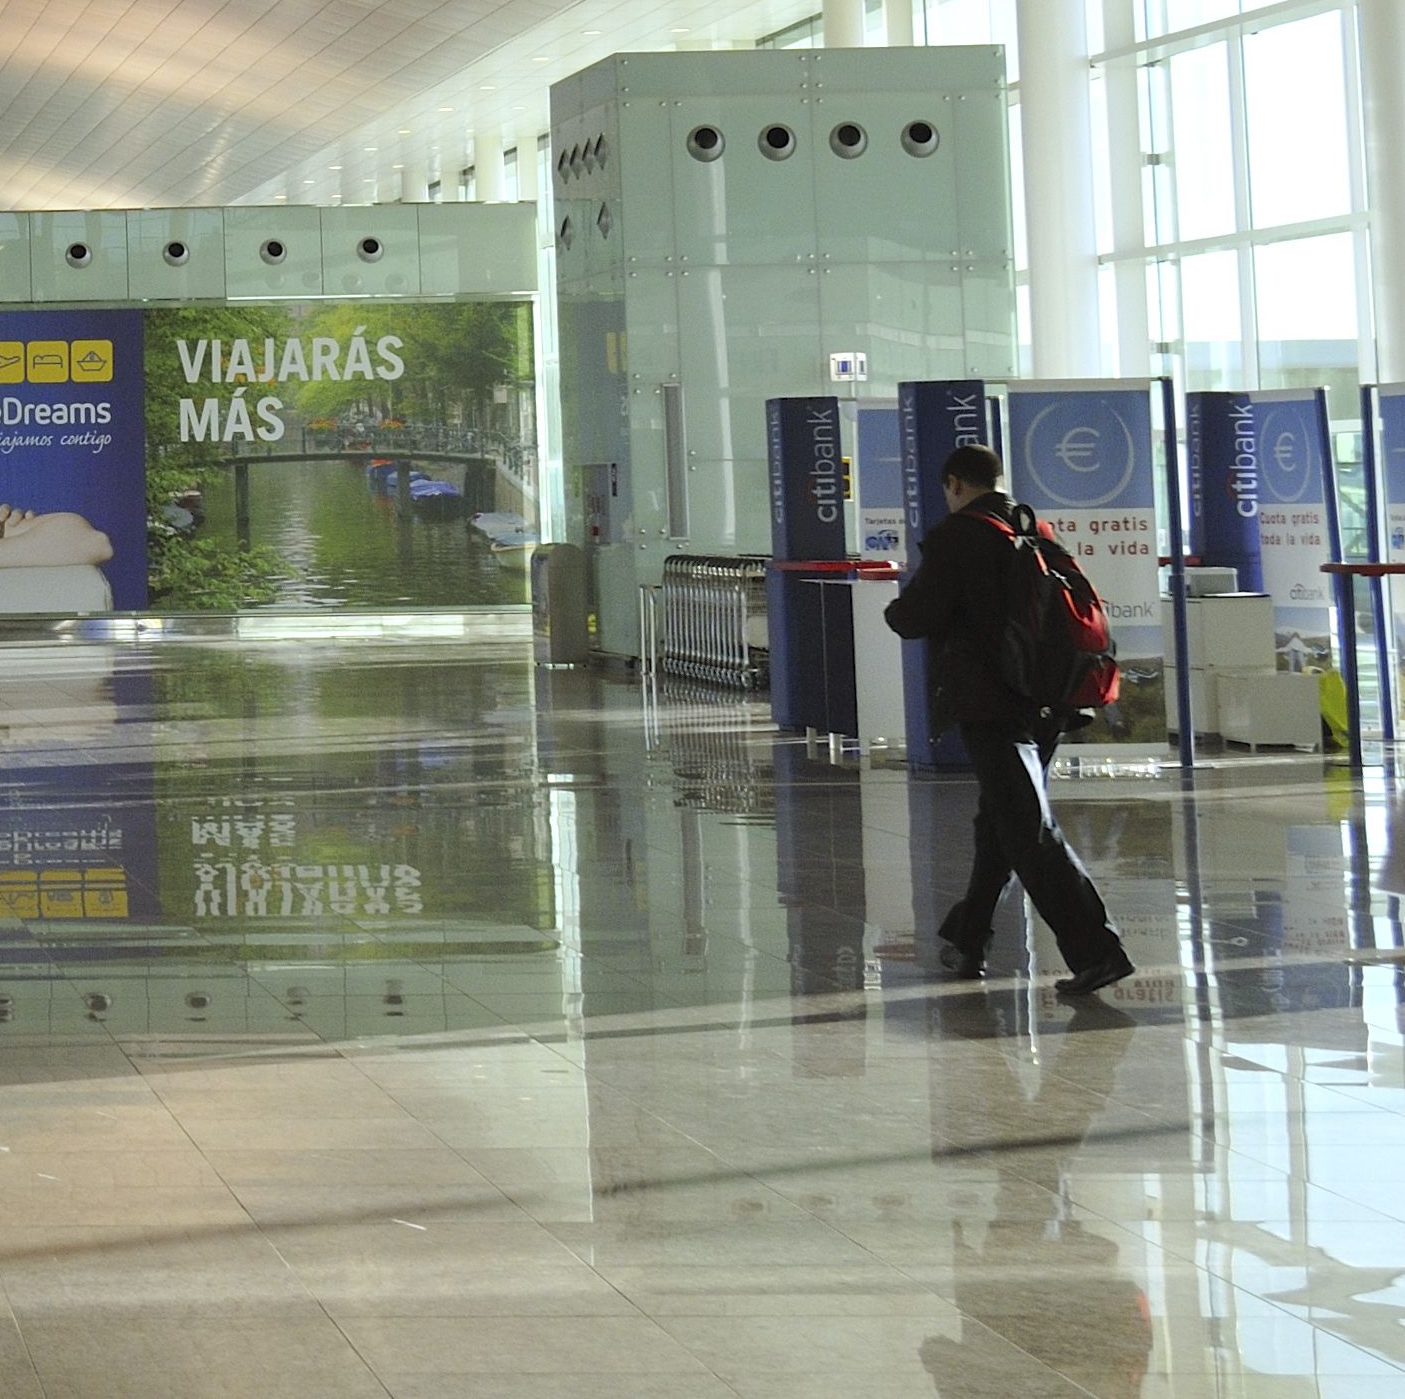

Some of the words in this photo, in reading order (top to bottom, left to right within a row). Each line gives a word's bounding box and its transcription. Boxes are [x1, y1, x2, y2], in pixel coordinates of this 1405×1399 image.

[176, 325, 405, 383] VIAJARÁS
[179, 387, 285, 442] MÁS
[60, 430, 112, 453] contigo
[807, 407, 838, 522] citibank
[903, 396, 920, 528] citibank
[1228, 403, 1258, 517] citibank
[1090, 516, 1148, 534] gratis
[1260, 511, 1286, 524] Cuota
[1292, 511, 1319, 527] gratis
[1077, 541, 1094, 555] la
[1108, 540, 1150, 555] vida
[1261, 534, 1281, 545] toda
[1286, 534, 1295, 545] la
[1300, 533, 1321, 545] vida
[1290, 585, 1323, 600] citibank
